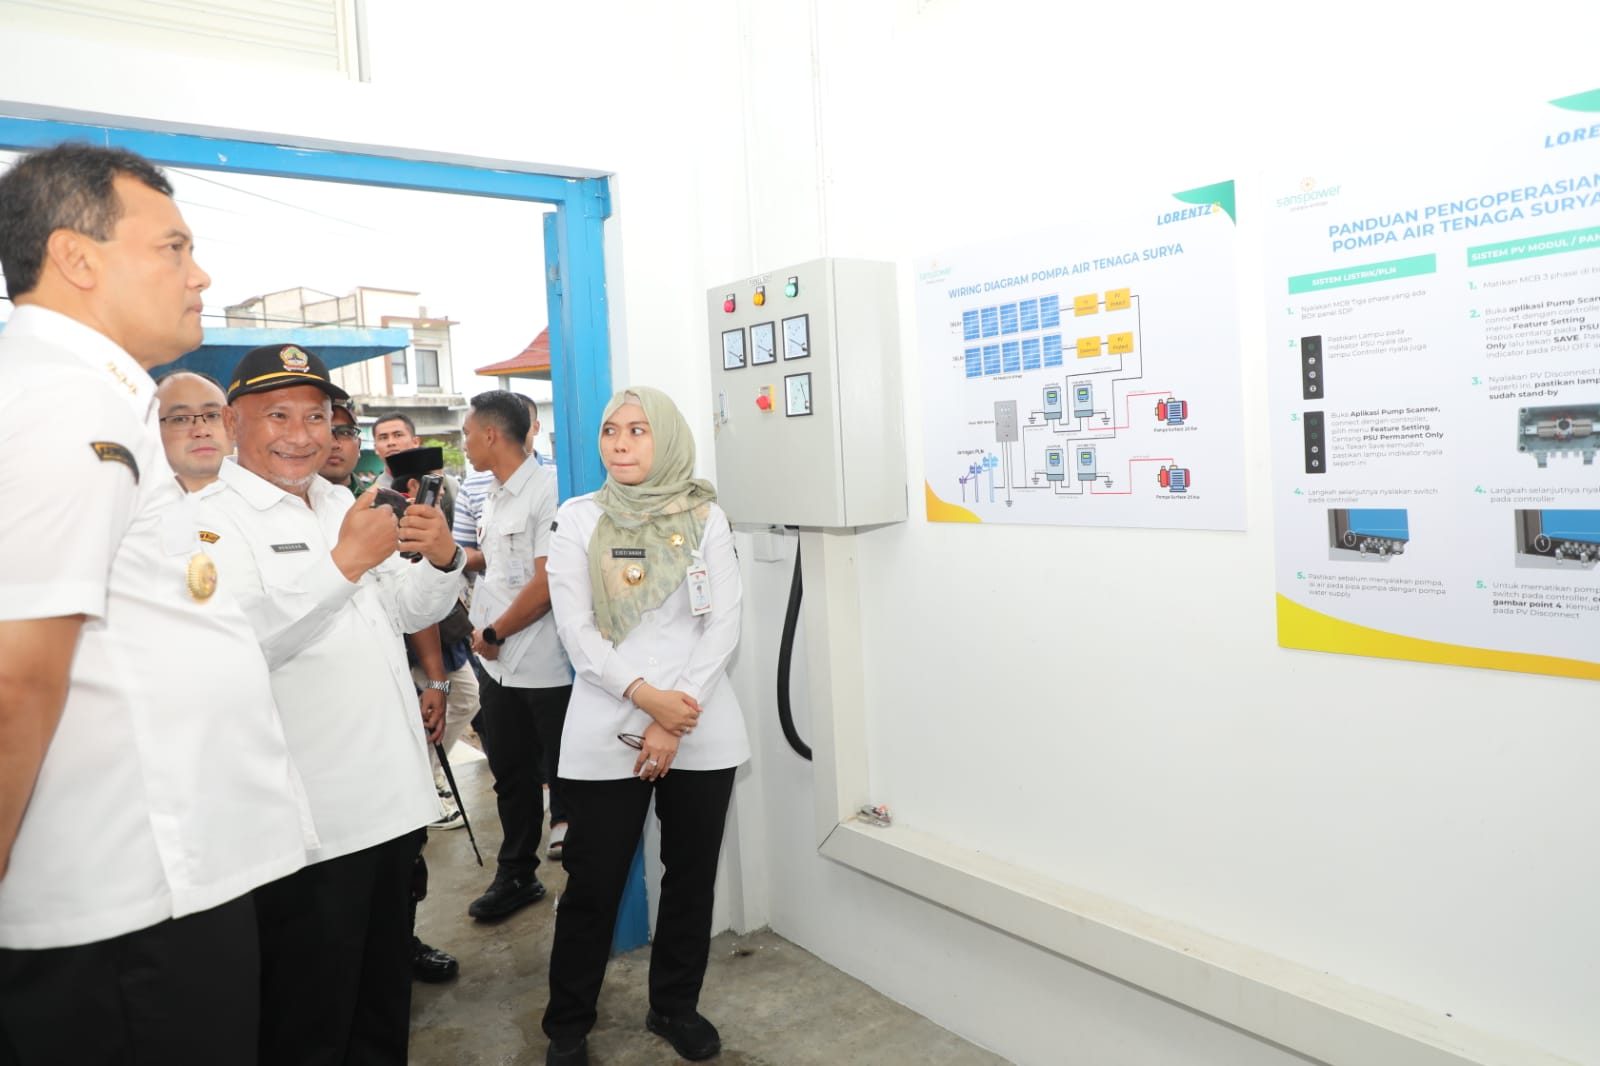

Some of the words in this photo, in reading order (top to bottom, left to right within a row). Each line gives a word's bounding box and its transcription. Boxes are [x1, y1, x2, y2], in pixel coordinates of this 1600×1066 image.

[1275, 184, 1341, 208] sanspower
[1157, 203, 1213, 226] LORENTZ
[1328, 209, 1419, 238] PANDUAN
[1332, 230, 1398, 252] POMPA
[1403, 223, 1435, 242] AIR
[1441, 208, 1524, 235] TENAGA
[1531, 192, 1600, 218] SURYA
[1472, 248, 1508, 263] SISTEM
[1510, 245, 1525, 257] PV
[1527, 239, 1568, 254] MODUL
[948, 284, 982, 299] WIRING
[984, 275, 1029, 292] DIAGRAM
[1031, 266, 1070, 283] POMPA
[1072, 261, 1090, 274] AIR
[1093, 251, 1139, 271] TENAGA
[1143, 243, 1184, 260] SURYA
[1312, 275, 1342, 288] SISTEM
[1343, 265, 1397, 282] LISTRIK/PLN
[1469, 282, 1477, 290] 1.
[1483, 278, 1517, 289] Matikan
[1550, 270, 1578, 280] phase
[1286, 307, 1294, 315] 1.
[1470, 309, 1480, 318] 2.
[1509, 303, 1544, 314] aplikasi
[1546, 299, 1575, 309] Pump
[1485, 315, 1520, 325] connect
[1521, 311, 1557, 323] dengan
[1513, 319, 1549, 330] Feature
[1550, 315, 1585, 327] Setting
[1553, 325, 1577, 336] pada
[1579, 323, 1599, 331] PSU
[1288, 340, 1297, 348] 2.
[1359, 331, 1385, 341] Lampu
[1486, 341, 1507, 351] Only
[1550, 343, 1570, 353] PSU
[1571, 342, 1591, 351] OFF
[1472, 376, 1482, 385] 3.
[1529, 371, 1542, 379] PV
[1544, 367, 1595, 378] Disconnect
[1534, 378, 1575, 389] pastikan
[1489, 391, 1516, 400] sudah
[1518, 388, 1559, 399] stand-by
[1290, 413, 1300, 422] 3.
[1350, 409, 1380, 418] Aplikasi
[1381, 408, 1405, 417] Pump
[1406, 405, 1441, 414] Scanner,
[1331, 418, 1359, 426] connect
[1360, 416, 1390, 425] dengan
[1370, 424, 1400, 433] Feature
[1401, 422, 1431, 432] Setting
[1380, 432, 1423, 440] Permanent
[1424, 430, 1445, 440] Only
[1294, 487, 1304, 496] 4.
[1413, 486, 1439, 495] switch
[1474, 485, 1487, 494] 4.
[1490, 486, 1528, 496] Langkah
[1528, 486, 1580, 496] selanjutnya
[1326, 495, 1359, 504] controller
[1490, 496, 1511, 504] pada
[1512, 495, 1556, 504] controller
[1297, 571, 1306, 580] 5.
[1388, 585, 1418, 596] dengan
[1418, 587, 1447, 597] pompa
[1475, 580, 1487, 589] 5.
[1492, 581, 1519, 590] Untuk
[1520, 583, 1572, 593] mematikan
[1328, 590, 1351, 600] supply
[1492, 590, 1521, 599] switch
[1521, 592, 1545, 601] pada
[1545, 593, 1591, 604] controller,
[1493, 599, 1527, 609] gambar
[1529, 600, 1554, 611] point
[1493, 607, 1515, 617] pada
[1516, 608, 1530, 617] PV
[1530, 609, 1580, 619] Disconnect
